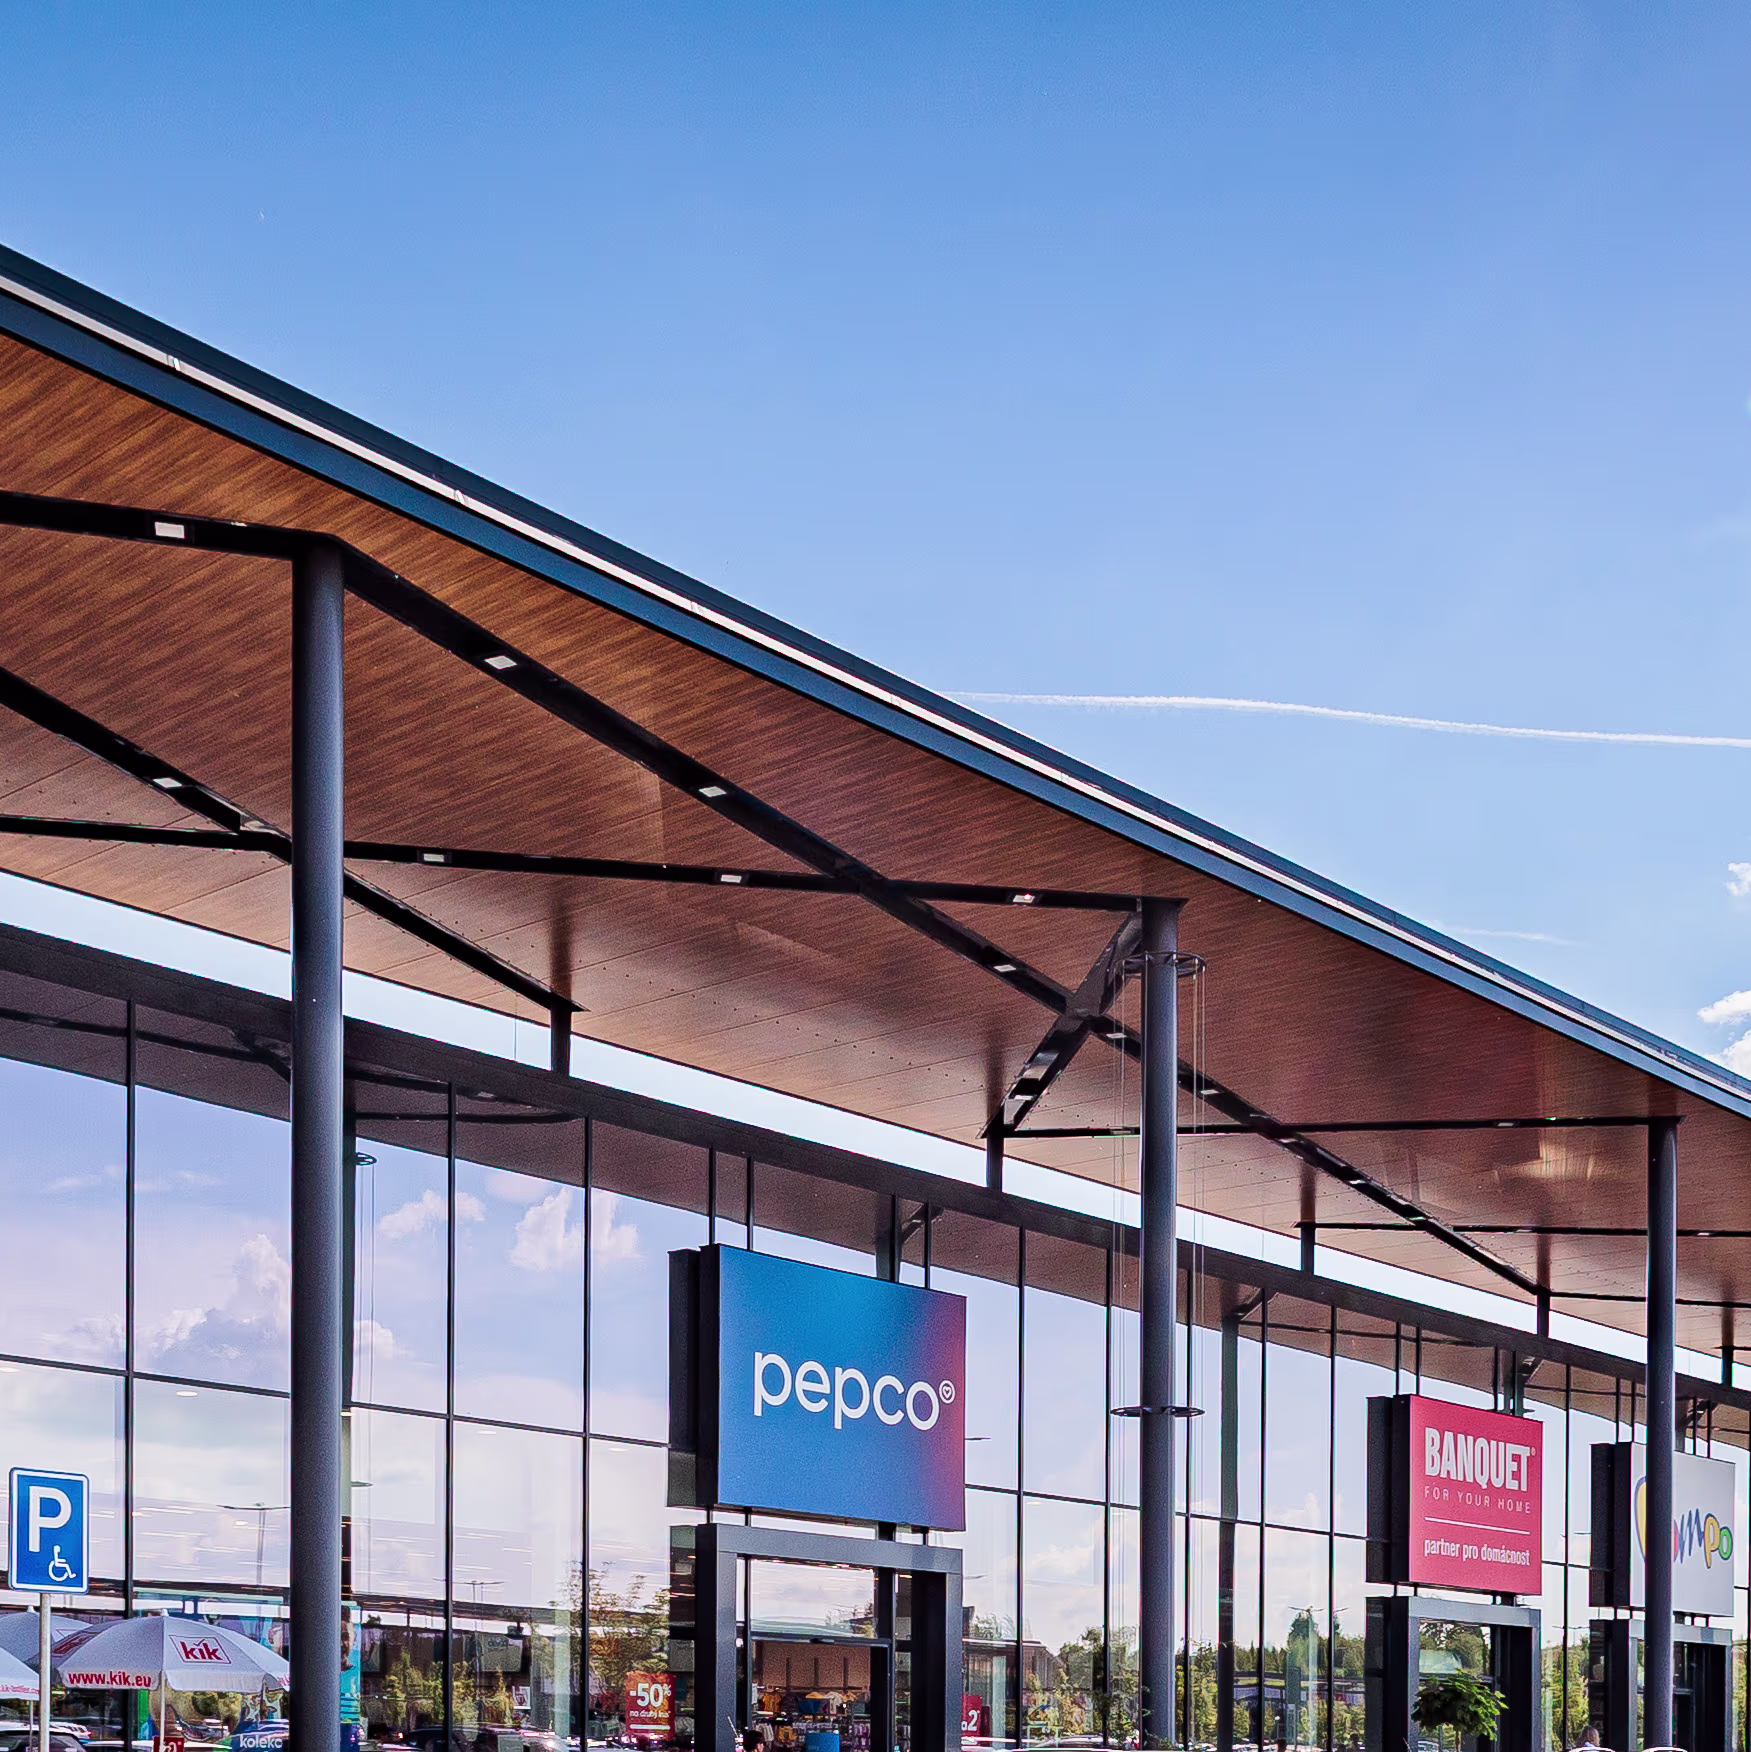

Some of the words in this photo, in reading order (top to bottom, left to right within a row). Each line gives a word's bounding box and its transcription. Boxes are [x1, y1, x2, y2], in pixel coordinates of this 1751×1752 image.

[753, 1351, 940, 1431] pepco
[1425, 1427, 1531, 1492] BANQUET
[1424, 1486, 1449, 1501] FOR
[1457, 1491, 1490, 1507] YOUR
[1498, 1498, 1531, 1514] HOME
[28, 1487, 72, 1553] P
[1424, 1538, 1461, 1557] partner
[1462, 1544, 1479, 1561] pro
[1481, 1543, 1531, 1566] domácnost
[179, 1636, 223, 1661] kik
[68, 1670, 152, 1688] www.kik.eu
[629, 1682, 672, 1708] -50%
